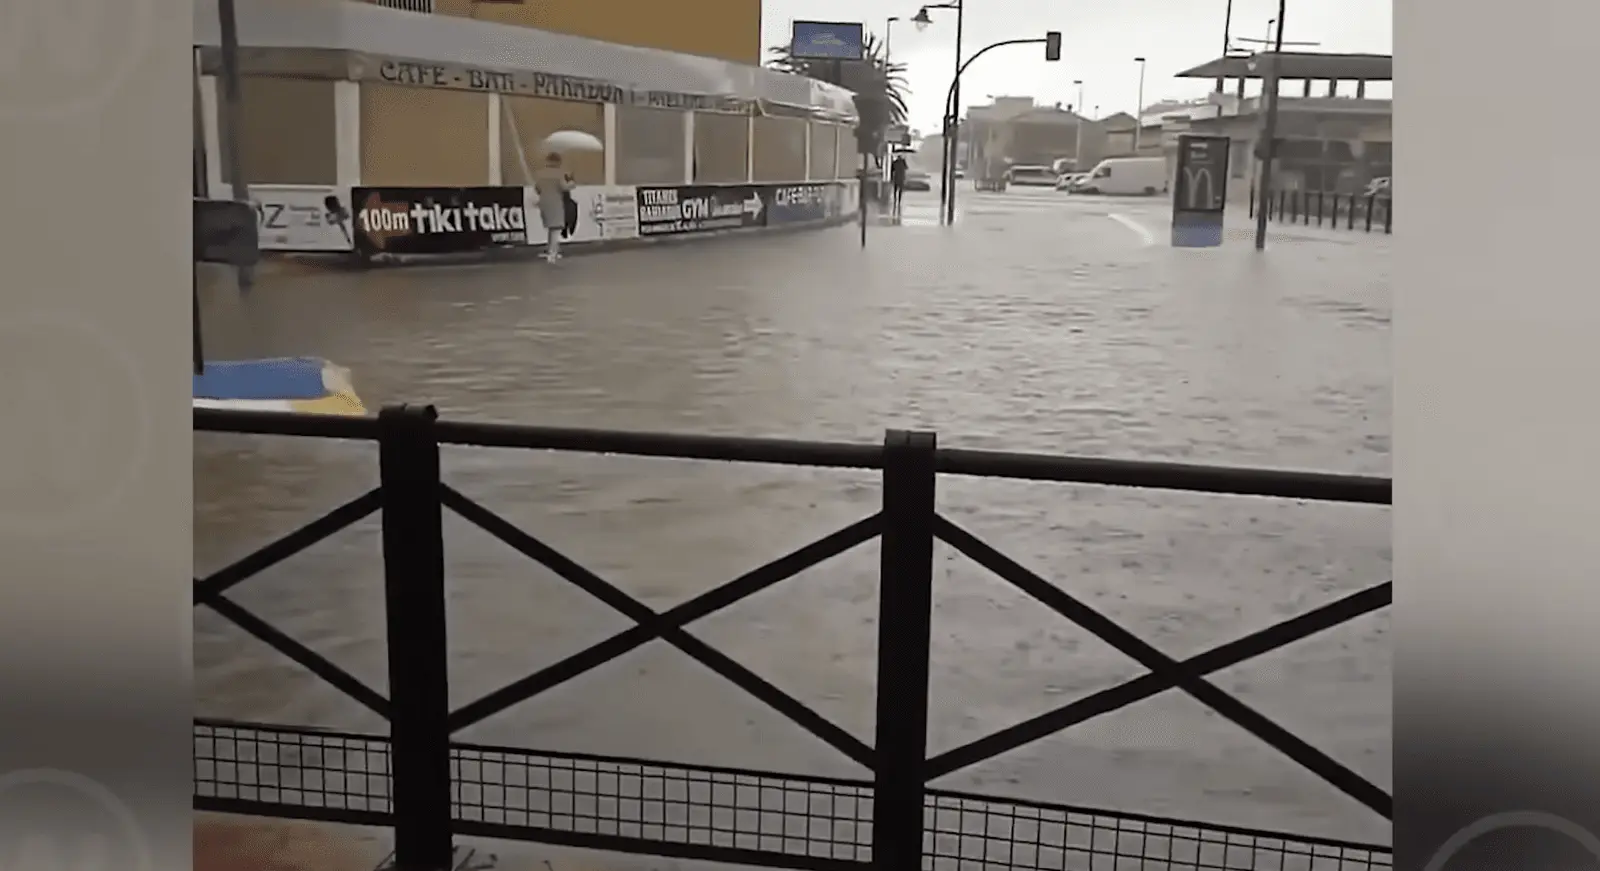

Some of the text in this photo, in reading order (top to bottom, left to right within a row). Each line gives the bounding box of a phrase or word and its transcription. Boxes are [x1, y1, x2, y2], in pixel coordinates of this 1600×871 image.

[359, 198, 524, 233] 100m tiki taka
[682, 197, 708, 219] GYM
